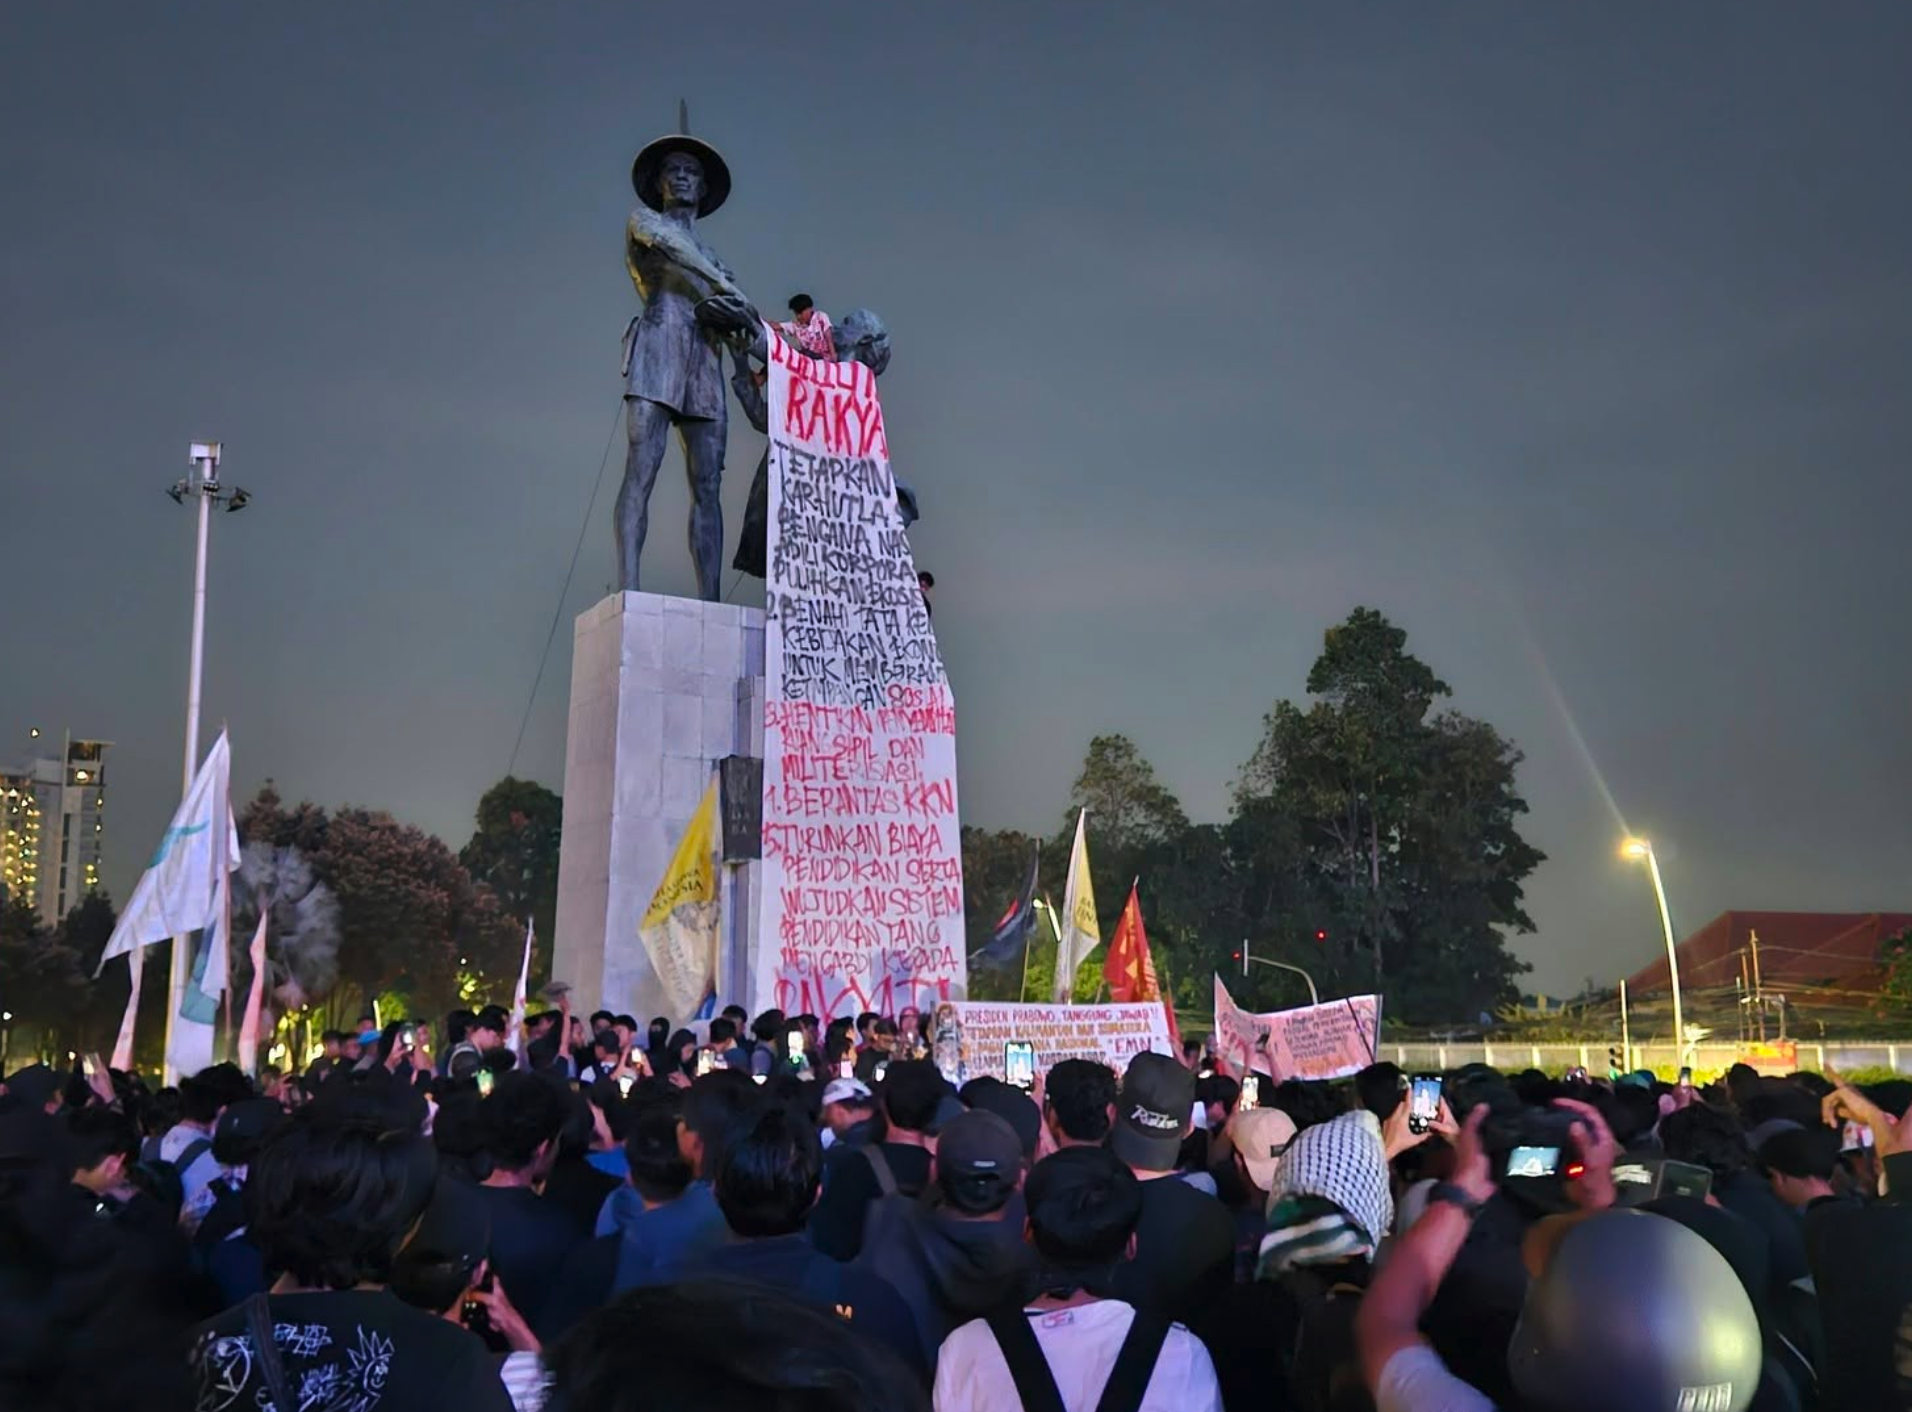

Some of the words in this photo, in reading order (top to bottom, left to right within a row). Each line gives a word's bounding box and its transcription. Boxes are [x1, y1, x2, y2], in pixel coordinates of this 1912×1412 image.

[783, 478, 889, 527] KARHUTLA
[853, 605, 901, 638] TATA
[783, 652, 842, 684] UNTUK
[889, 737, 924, 760] DAN
[784, 782, 901, 818] BERANTAS
[903, 778, 954, 821] KKN
[888, 821, 942, 857] BIAYA
[782, 855, 900, 885] PENDIDIKAN
[906, 857, 960, 885] SERTA
[780, 886, 886, 917] WUJUDKAN
[780, 914, 880, 948] PENDIDIKAN
[876, 917, 941, 949] YANG
[965, 1009, 1008, 1023] PRESIDEN
[1062, 1009, 1112, 1022] TANGGUNG
